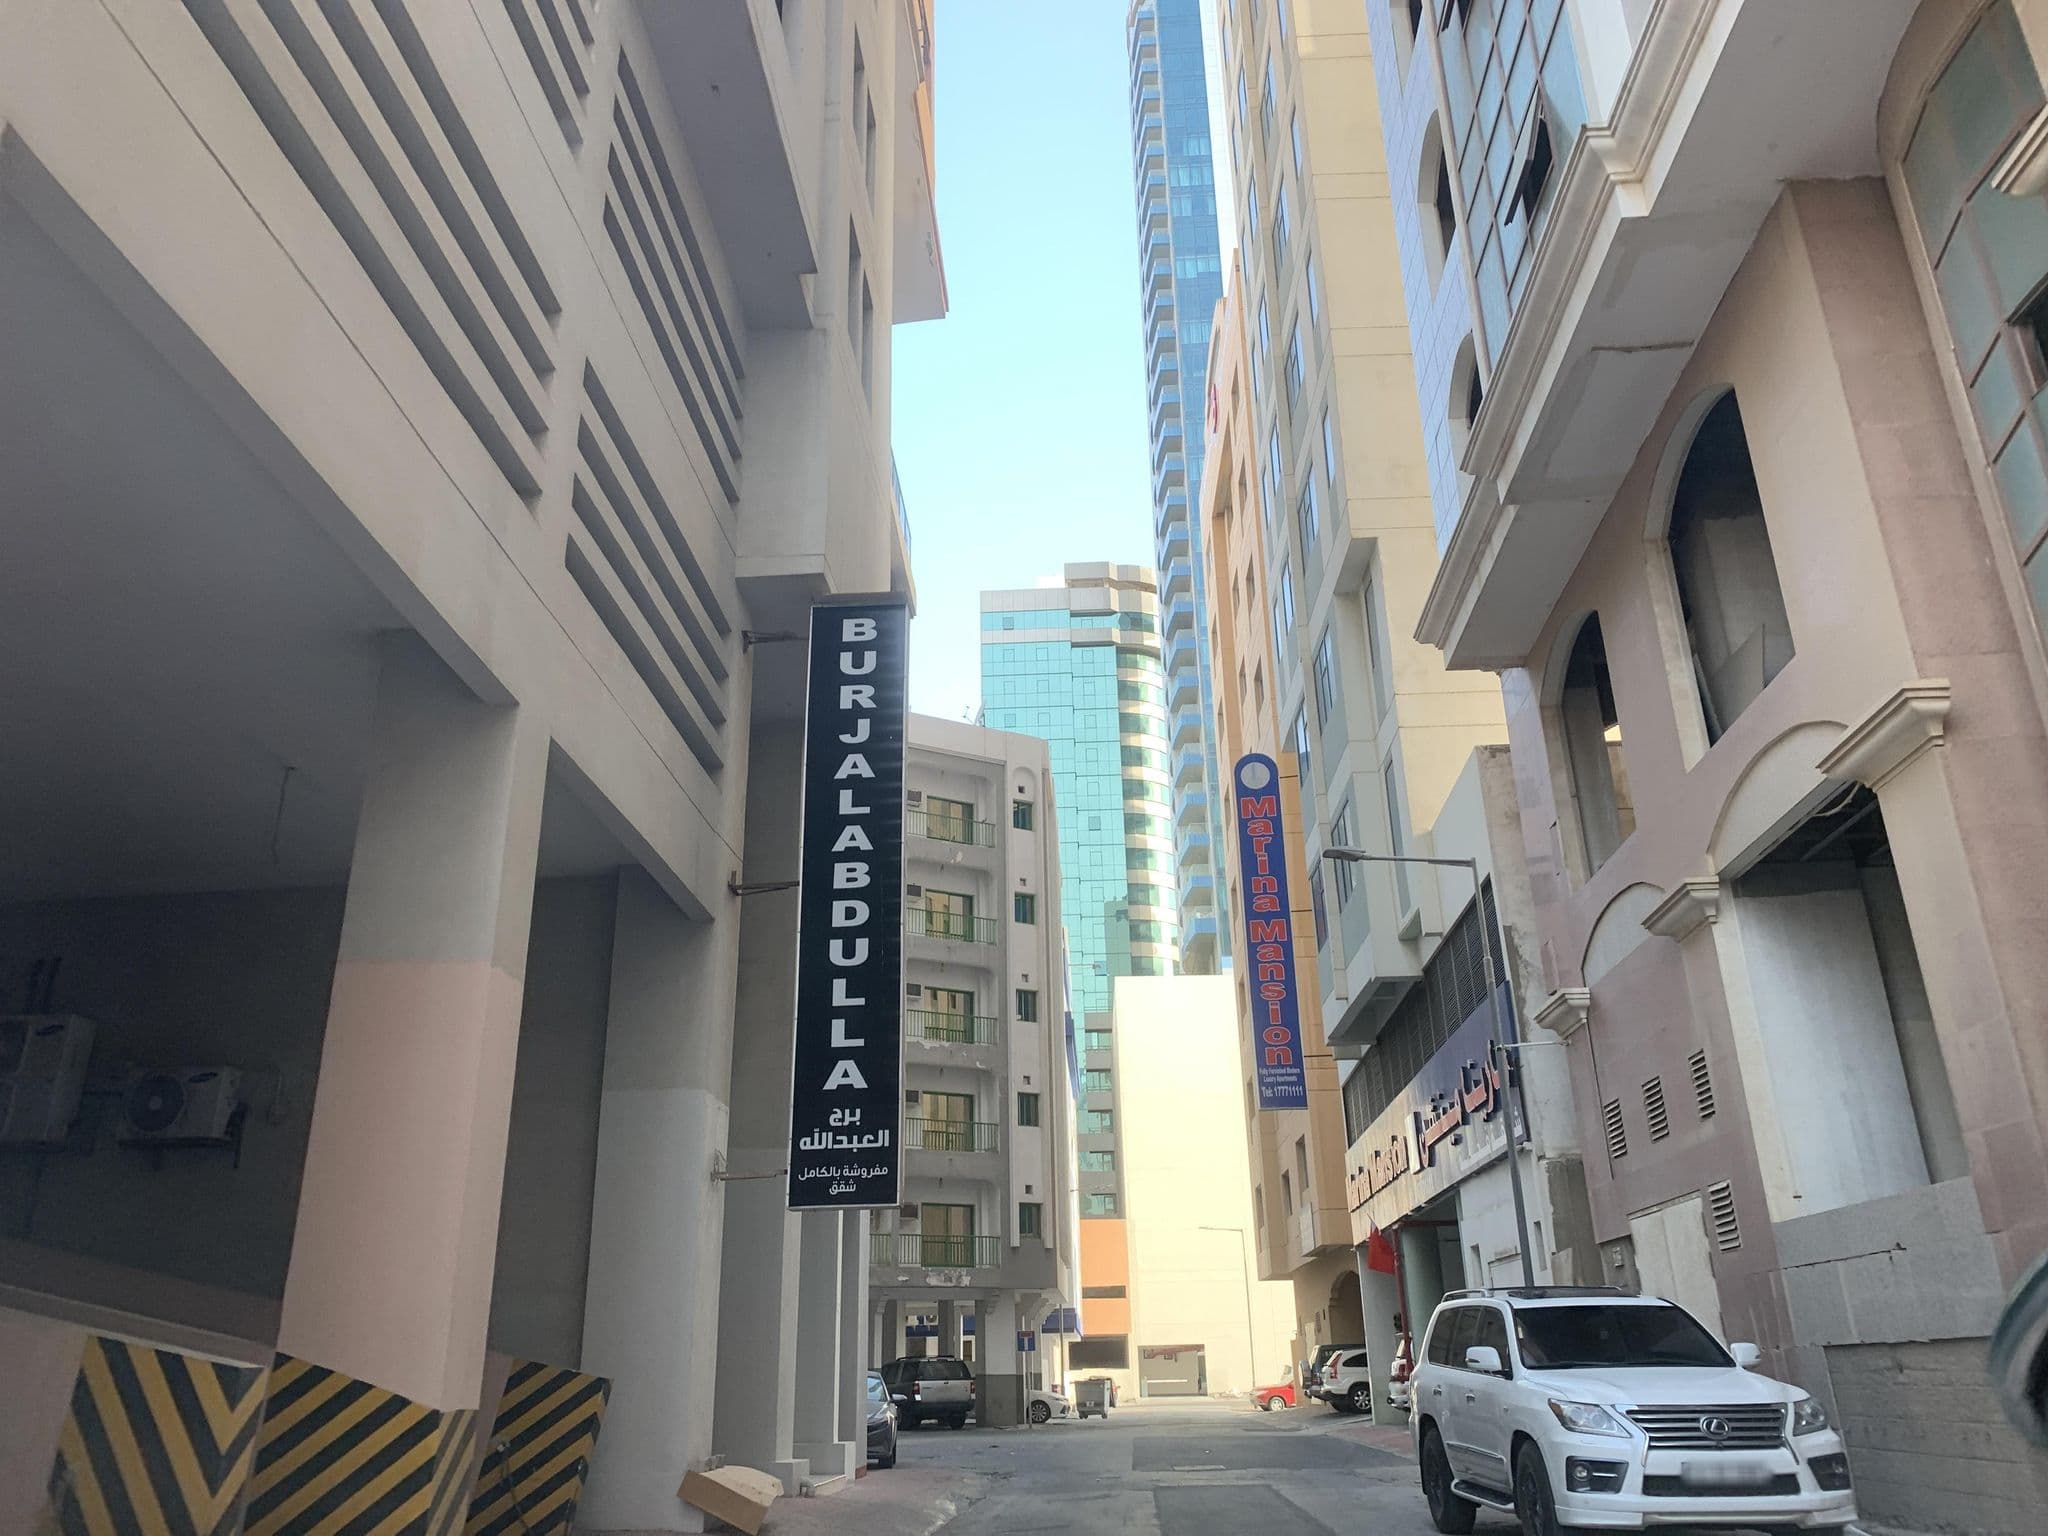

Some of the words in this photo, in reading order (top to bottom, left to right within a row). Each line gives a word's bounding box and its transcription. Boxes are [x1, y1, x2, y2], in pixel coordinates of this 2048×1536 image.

[1240, 796, 1282, 913] Marina
[1250, 919, 1293, 1067] Mansion
[829, 1108, 861, 1127] برج
[798, 1165, 841, 1181] بالكامل
[842, 1162, 889, 1179] مفروشة
[829, 1179, 857, 1195] شقق
